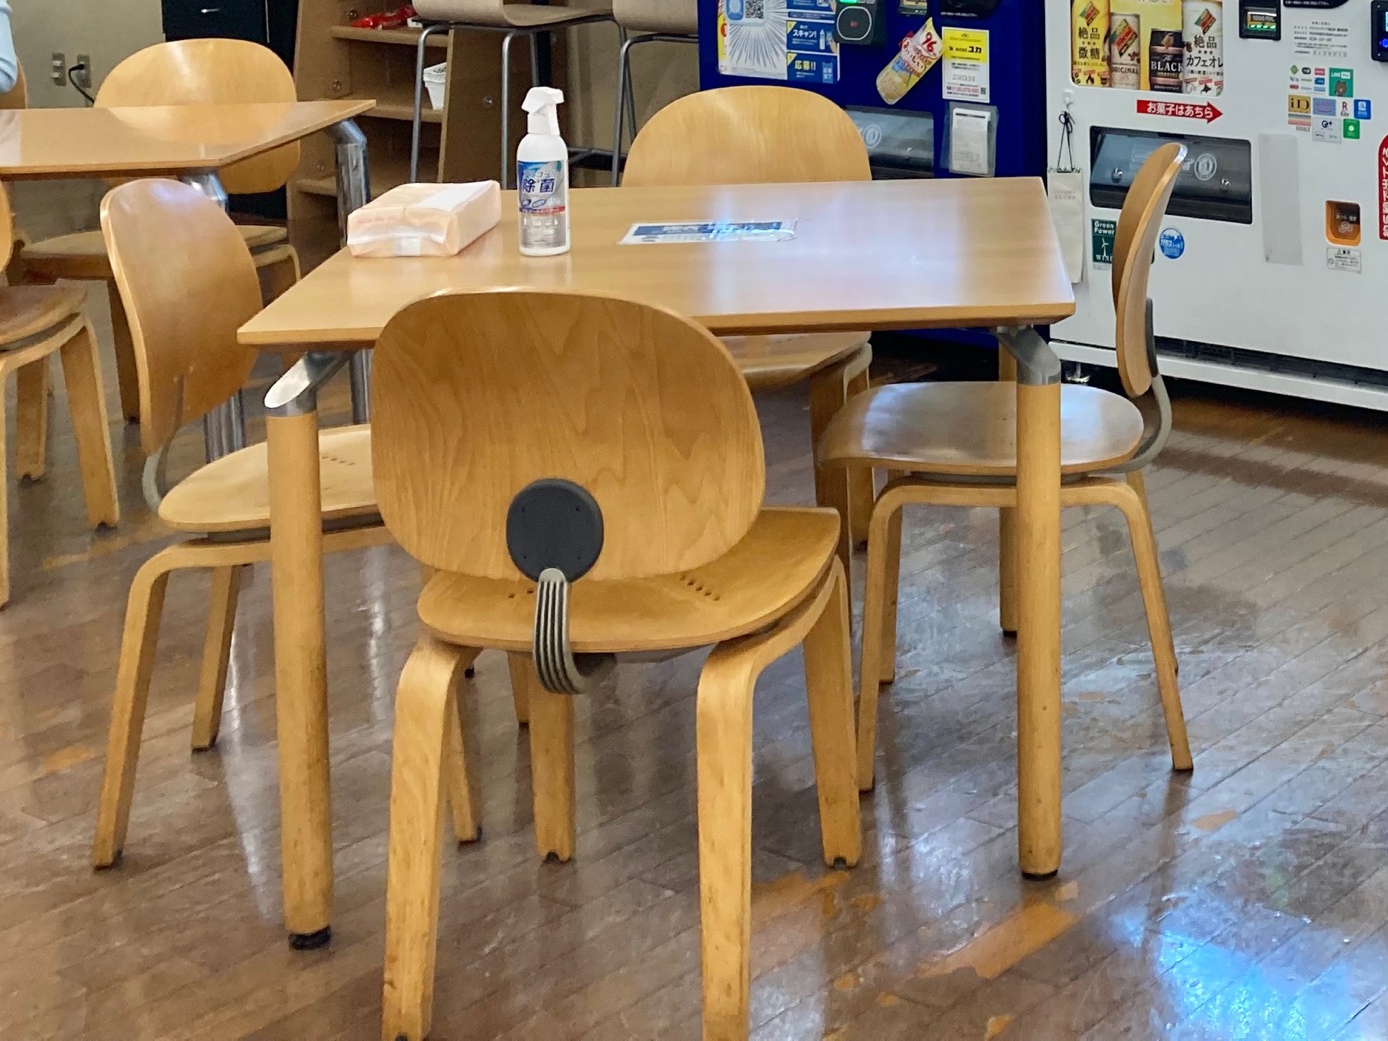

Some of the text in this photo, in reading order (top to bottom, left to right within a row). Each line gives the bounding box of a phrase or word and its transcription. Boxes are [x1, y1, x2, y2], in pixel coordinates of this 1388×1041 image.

[1078, 26, 1100, 40] 絶品
[1193, 35, 1217, 49] 絶品
[1078, 47, 1100, 60] 微糖
[1151, 60, 1183, 72] BLACK
[1186, 54, 1223, 68] カフェオレ
[1146, 102, 1214, 118] お菓子はあちら
[1290, 97, 1310, 110] iD
[522, 178, 556, 193] 除菌
